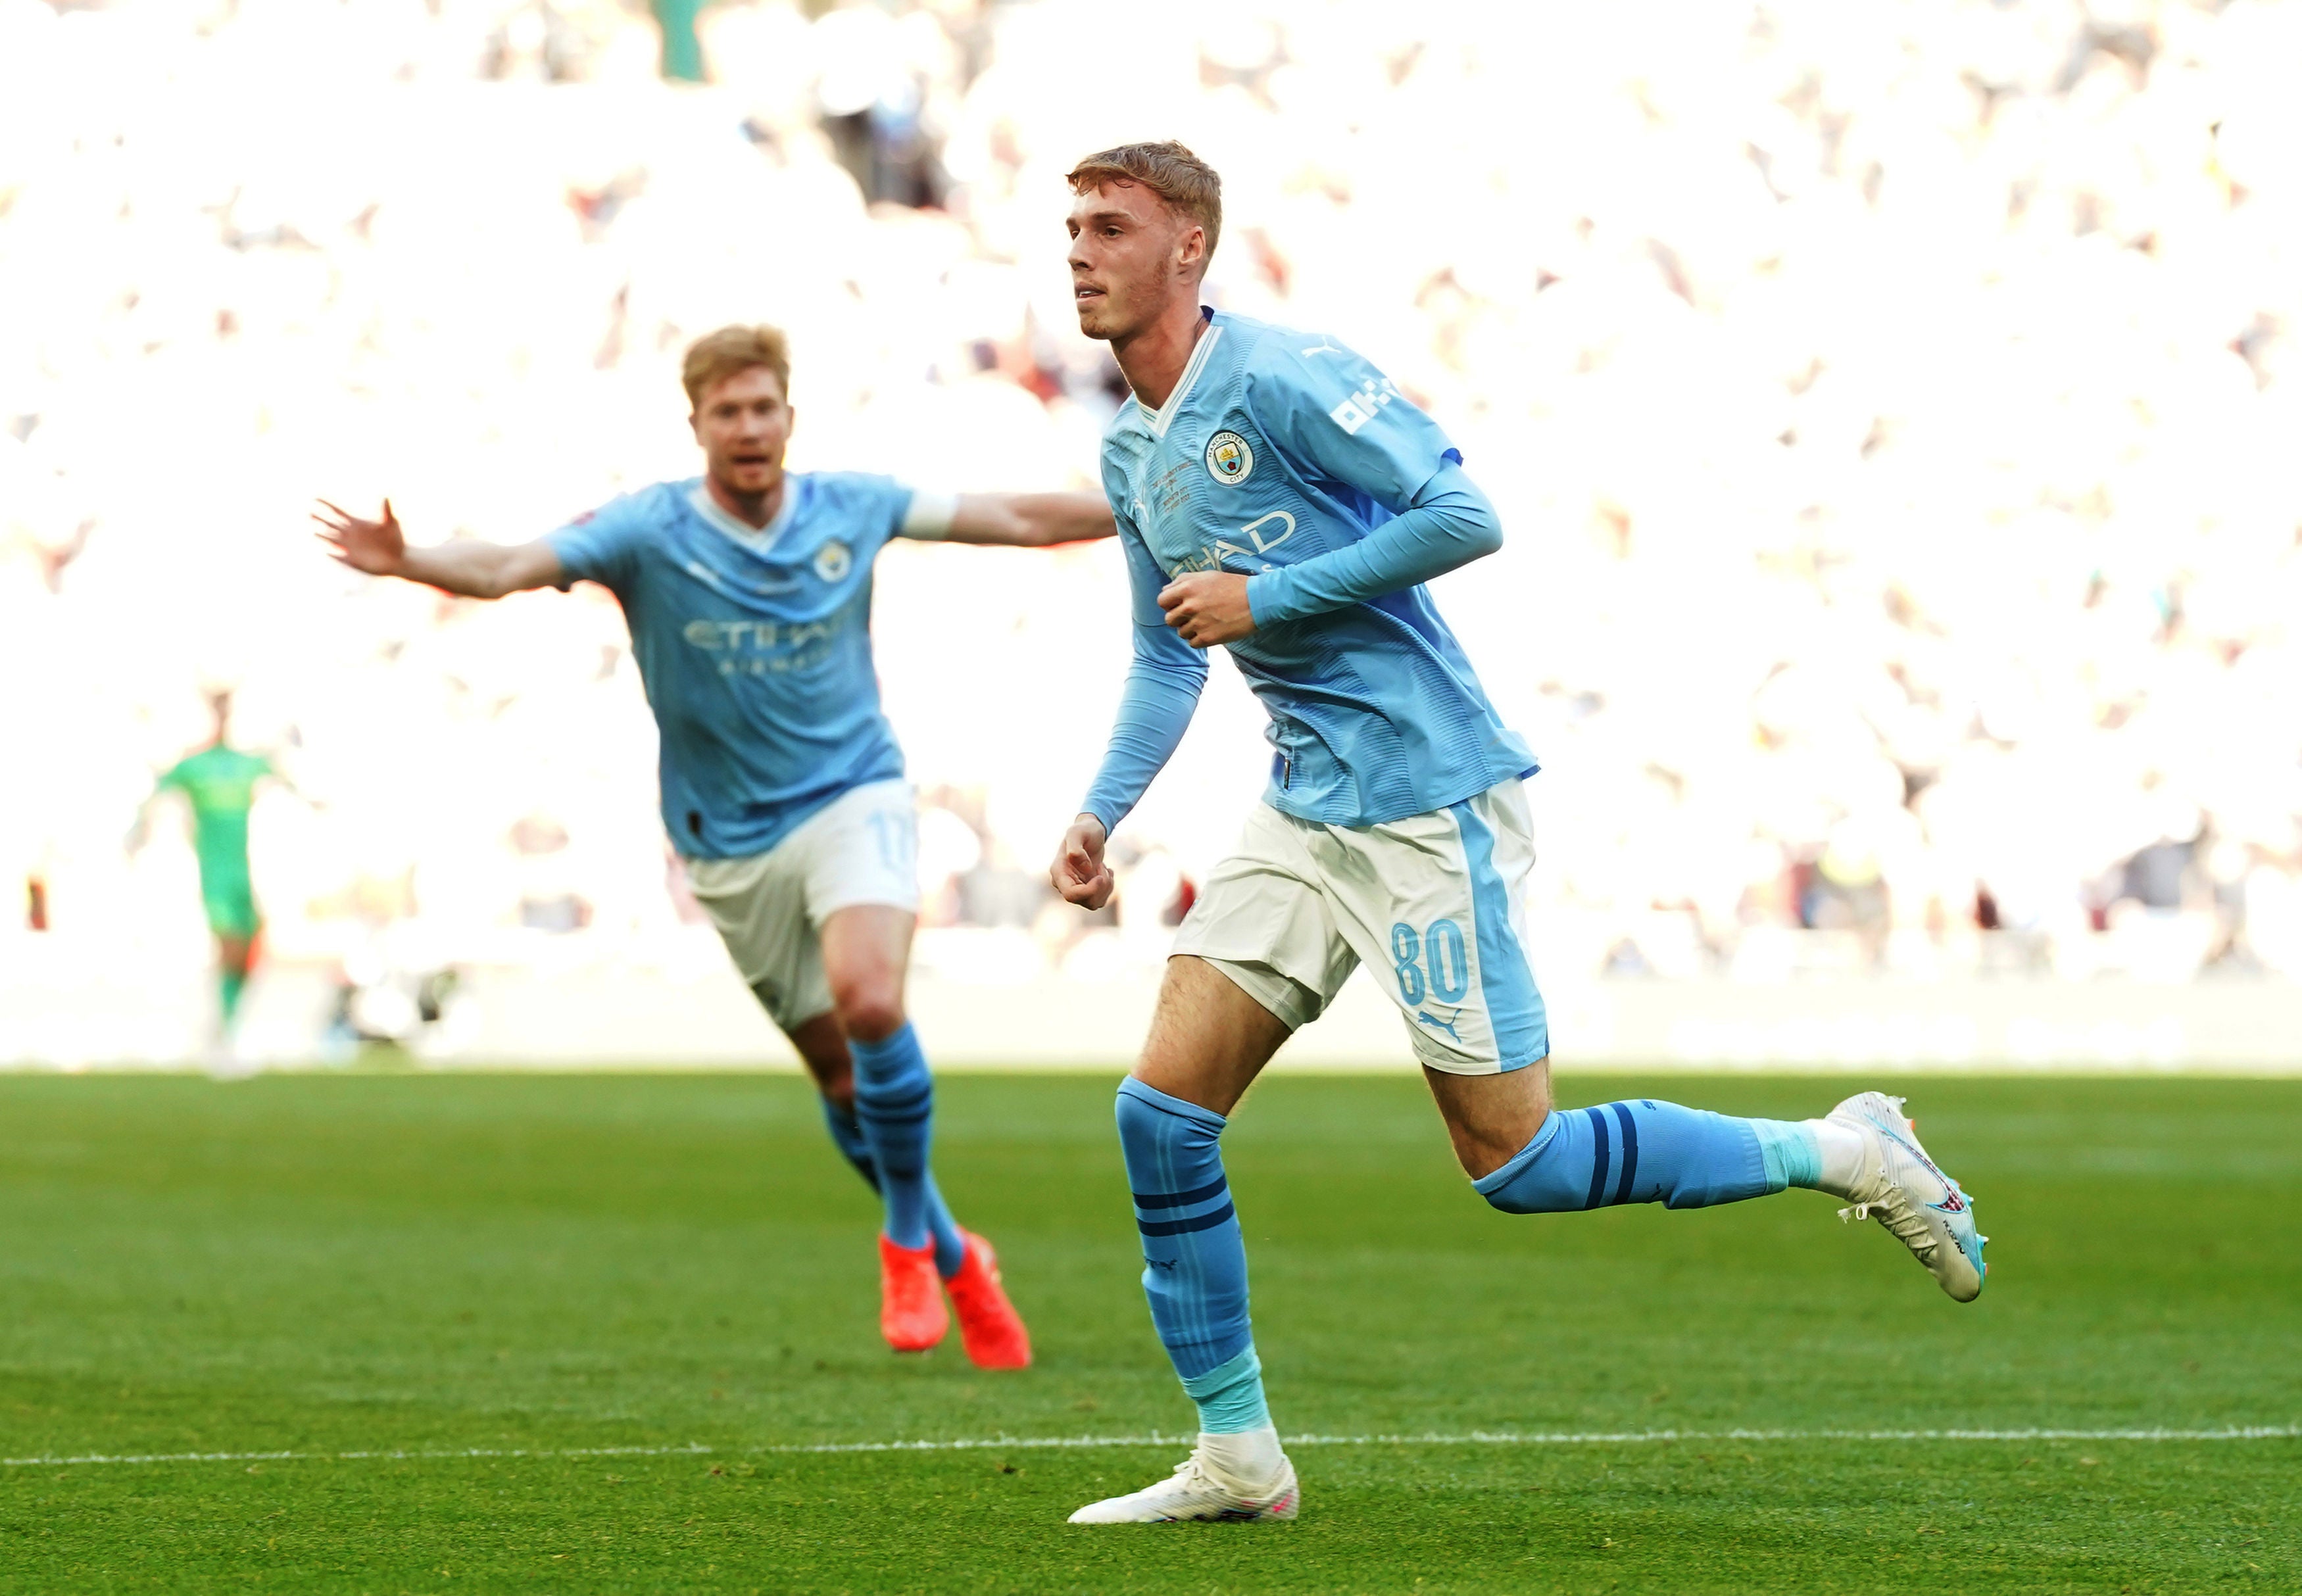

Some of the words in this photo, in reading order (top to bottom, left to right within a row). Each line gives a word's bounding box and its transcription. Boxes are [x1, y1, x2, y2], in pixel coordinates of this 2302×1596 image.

[1208, 434, 1242, 458] MANCHESTER
[1229, 473, 1244, 482] CITY
[1169, 510, 1296, 580] IHAD
[683, 605, 855, 651] ETI
[1392, 919, 1469, 1006] 80
